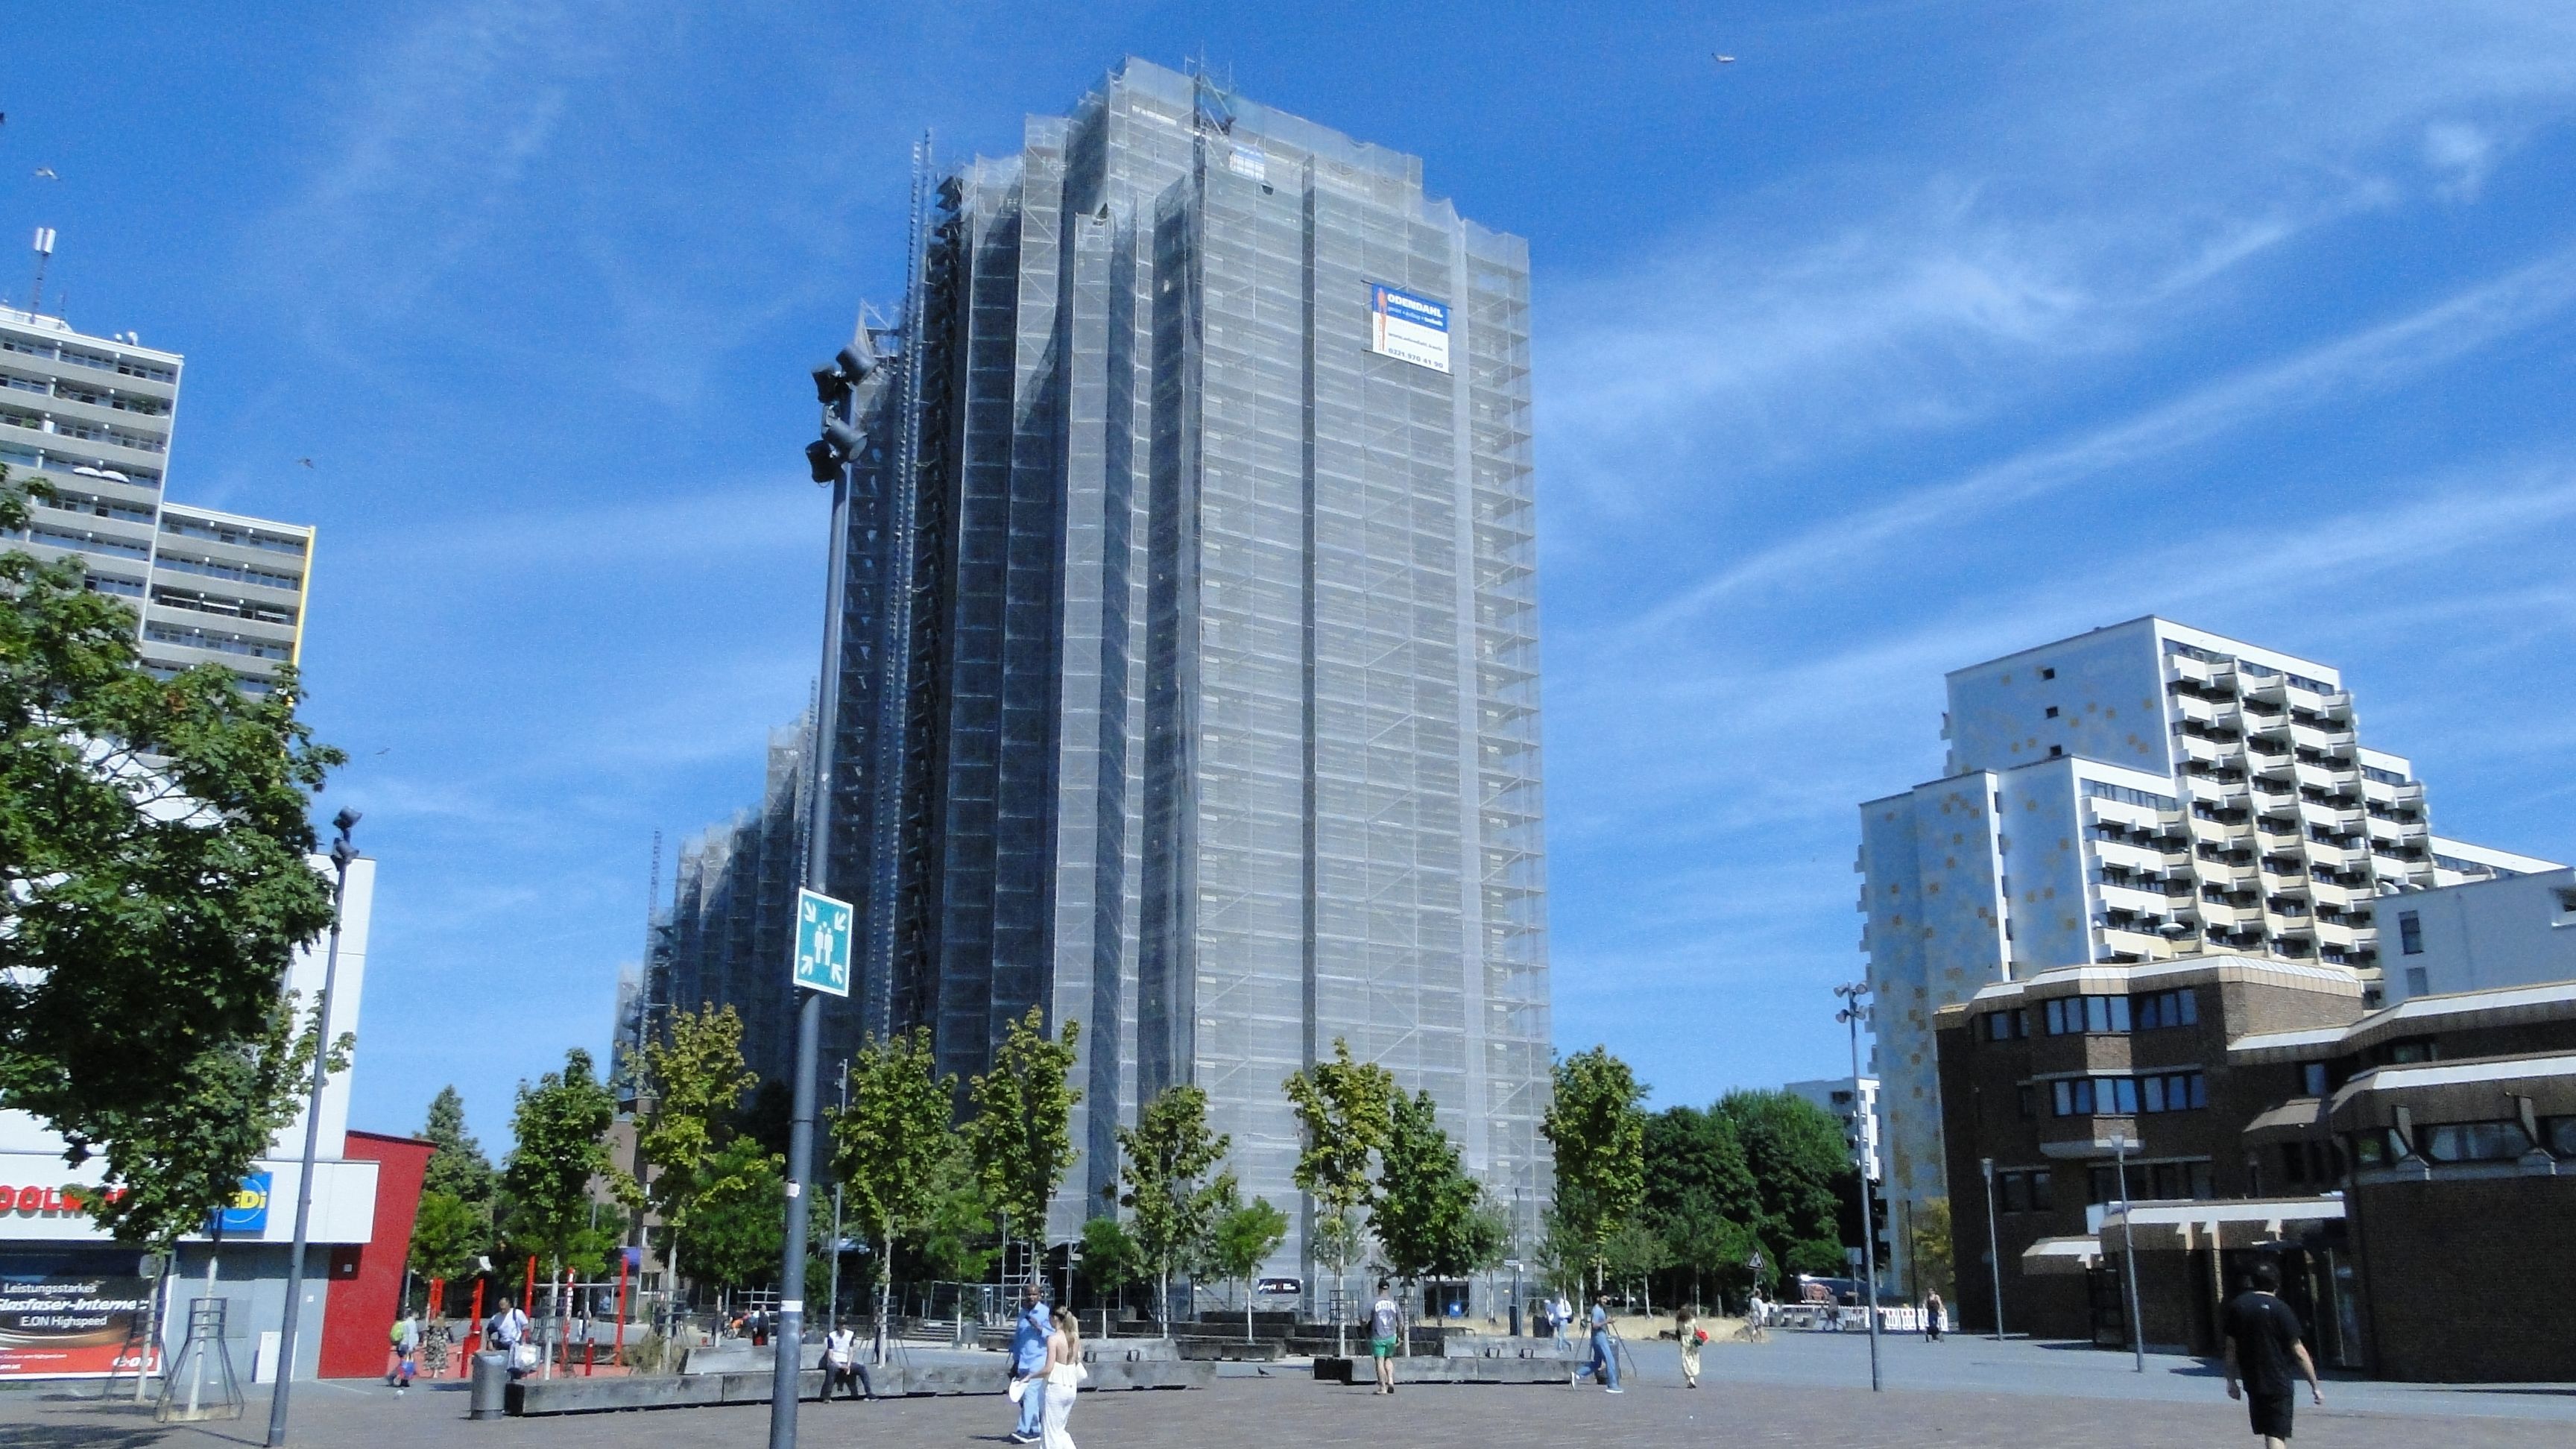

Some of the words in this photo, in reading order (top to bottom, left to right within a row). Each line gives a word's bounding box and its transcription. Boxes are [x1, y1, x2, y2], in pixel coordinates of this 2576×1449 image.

[1387, 294, 1444, 318] ODENDAHL
[1407, 353, 1421, 362] 970
[4, 1282, 97, 1295] Leistungsstarkes
[21, 1316, 50, 1326] E.ON
[51, 1316, 107, 1328] Highspeed
